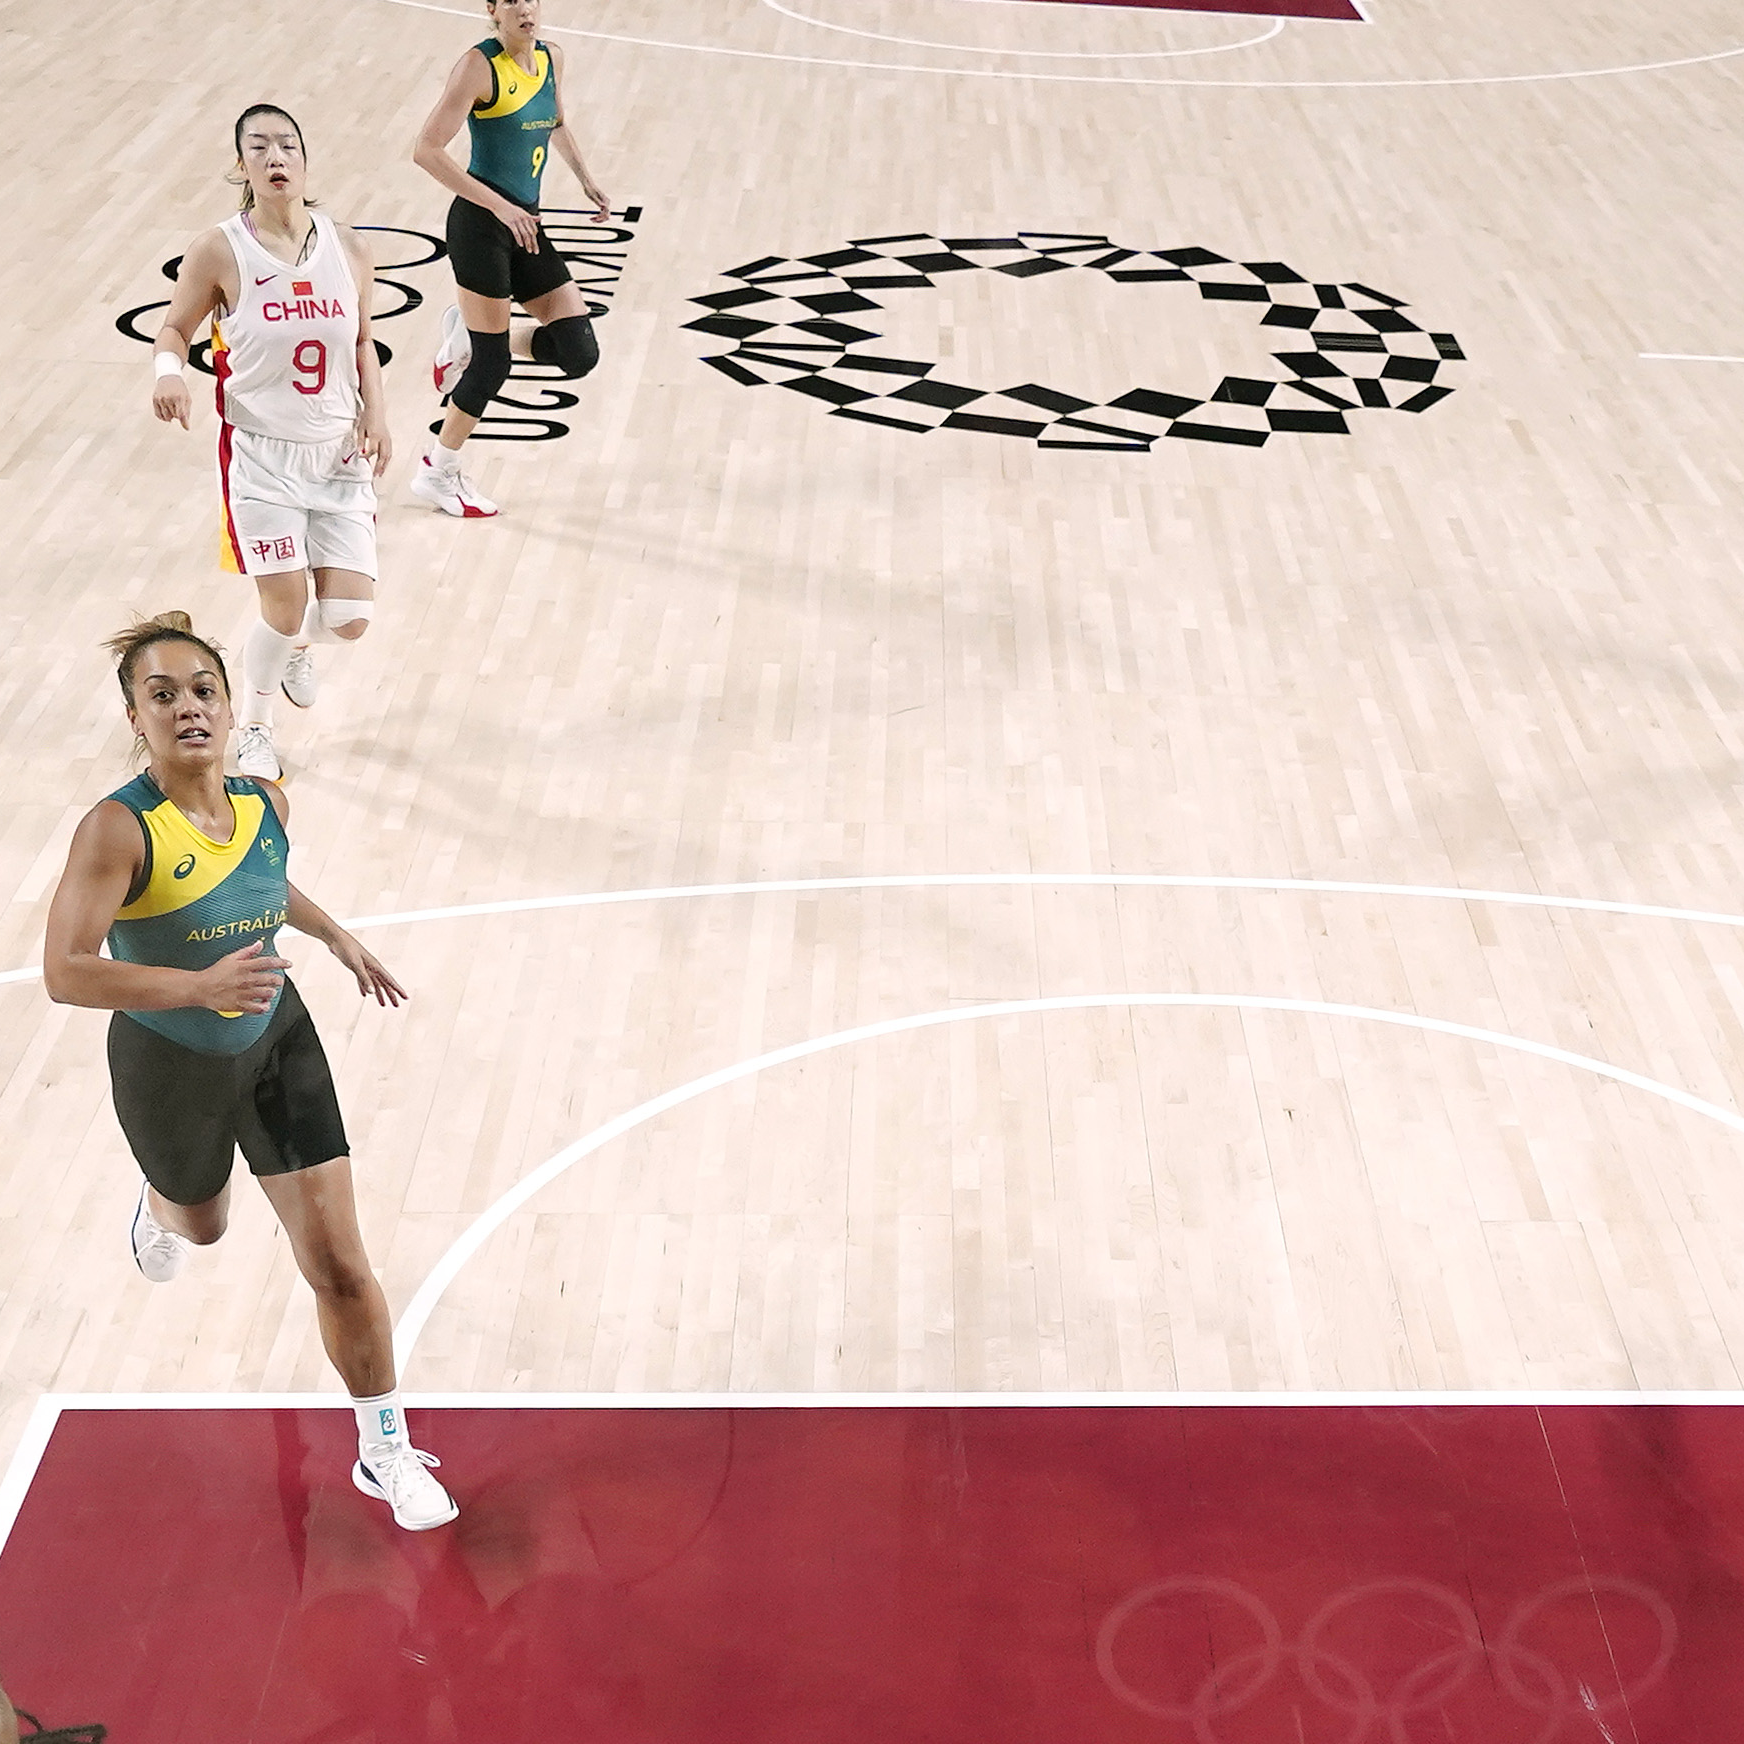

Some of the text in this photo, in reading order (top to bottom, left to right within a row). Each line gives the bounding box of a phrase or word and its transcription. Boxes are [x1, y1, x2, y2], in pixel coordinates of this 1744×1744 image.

[531, 145, 545, 179] 9
[262, 299, 346, 321] CHINA
[291, 339, 326, 395] 9
[251, 535, 296, 563] 中国
[185, 909, 289, 942] AUSTRALIA
